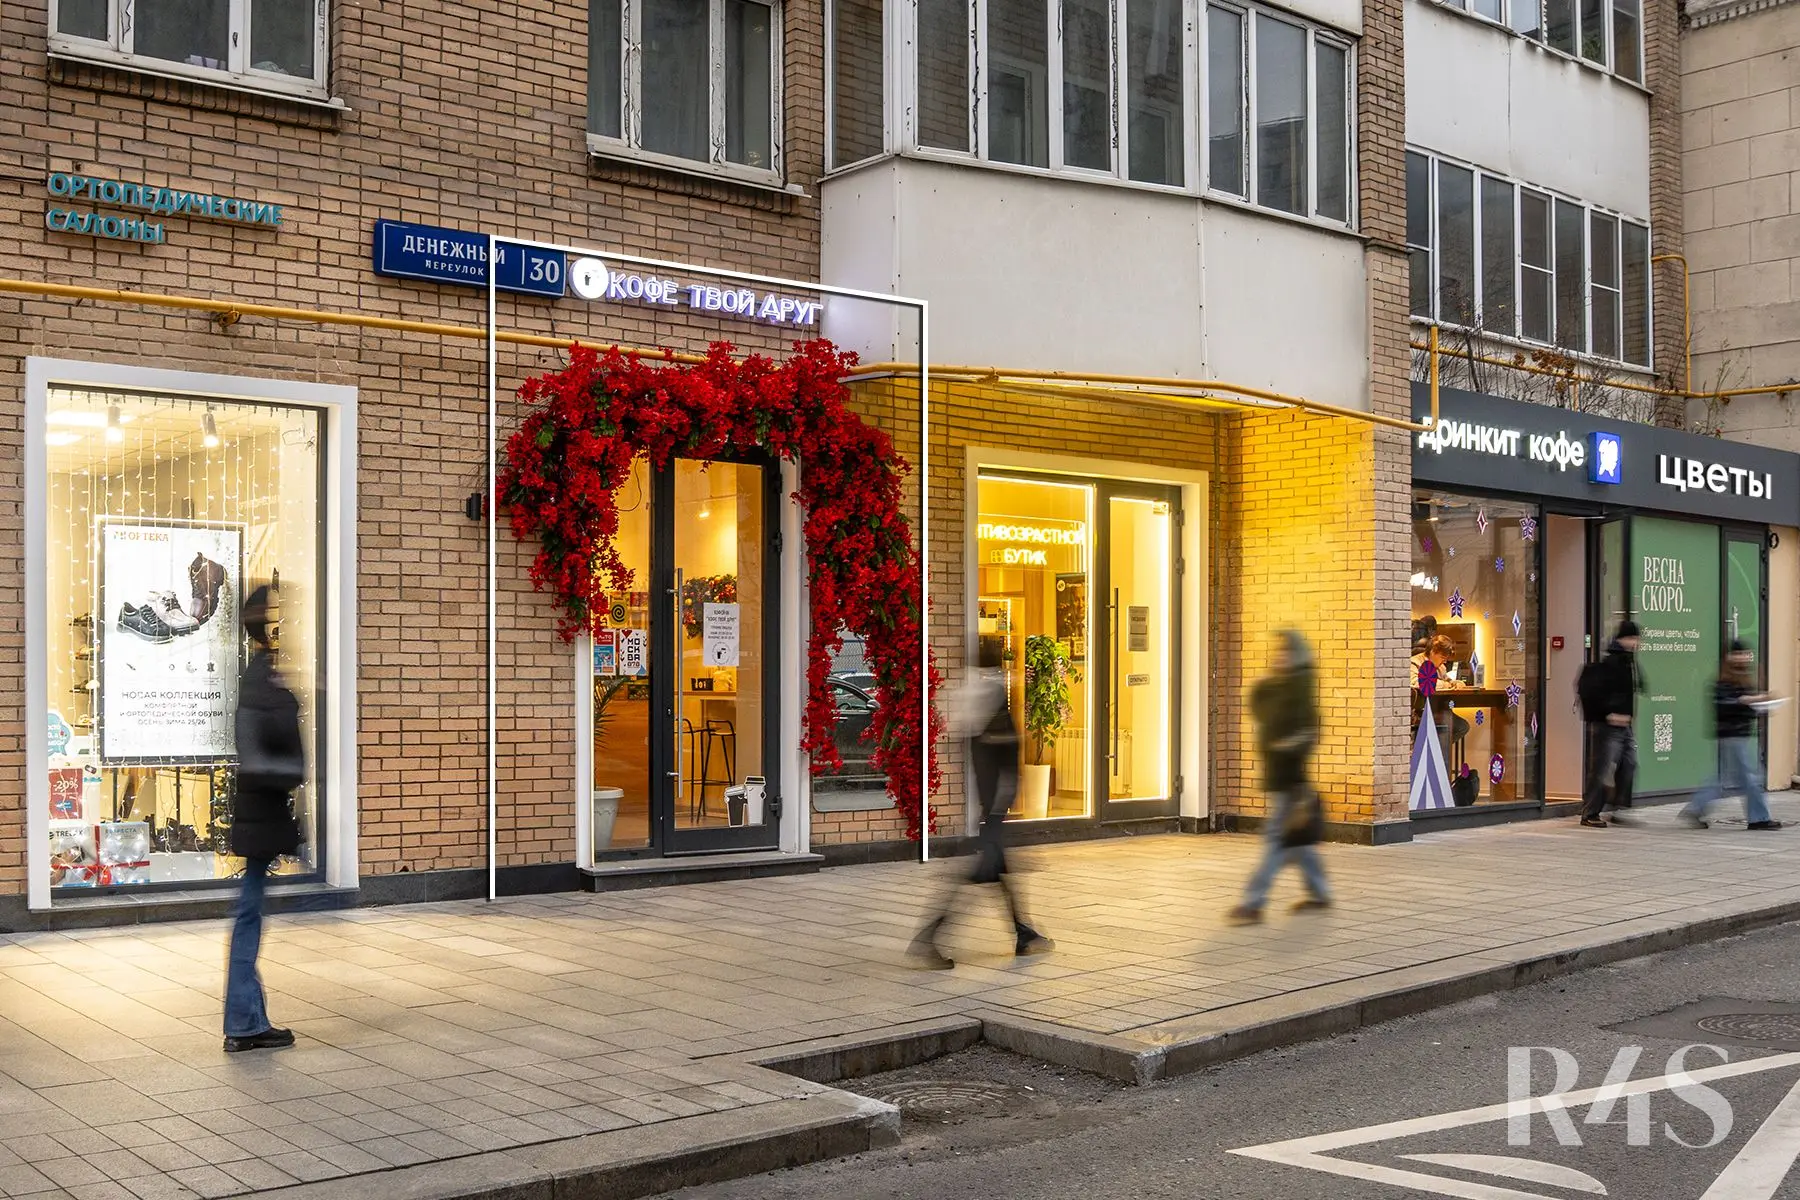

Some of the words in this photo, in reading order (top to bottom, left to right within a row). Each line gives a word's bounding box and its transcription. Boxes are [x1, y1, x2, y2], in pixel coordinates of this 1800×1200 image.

[48, 173, 283, 225] ОРТОПЕДИЧЕСКИЕ
[47, 208, 164, 244] САЛОНЫ
[425, 259, 485, 276] ПЕРЕУЛОК
[529, 257, 560, 284] 30
[608, 271, 679, 305] КОФЕ
[689, 284, 755, 317] ТВОЙ
[759, 293, 824, 325] ДРУГ
[1529, 430, 1584, 472] кофе
[1003, 547, 1048, 566] БУТИК
[1643, 556, 1685, 585] ВЕСНА
[1641, 584, 1692, 613] СКОРО...
[160, 691, 221, 701] КОЛЛЕКЦИЯ
[198, 711, 223, 719] ОБУВИ
